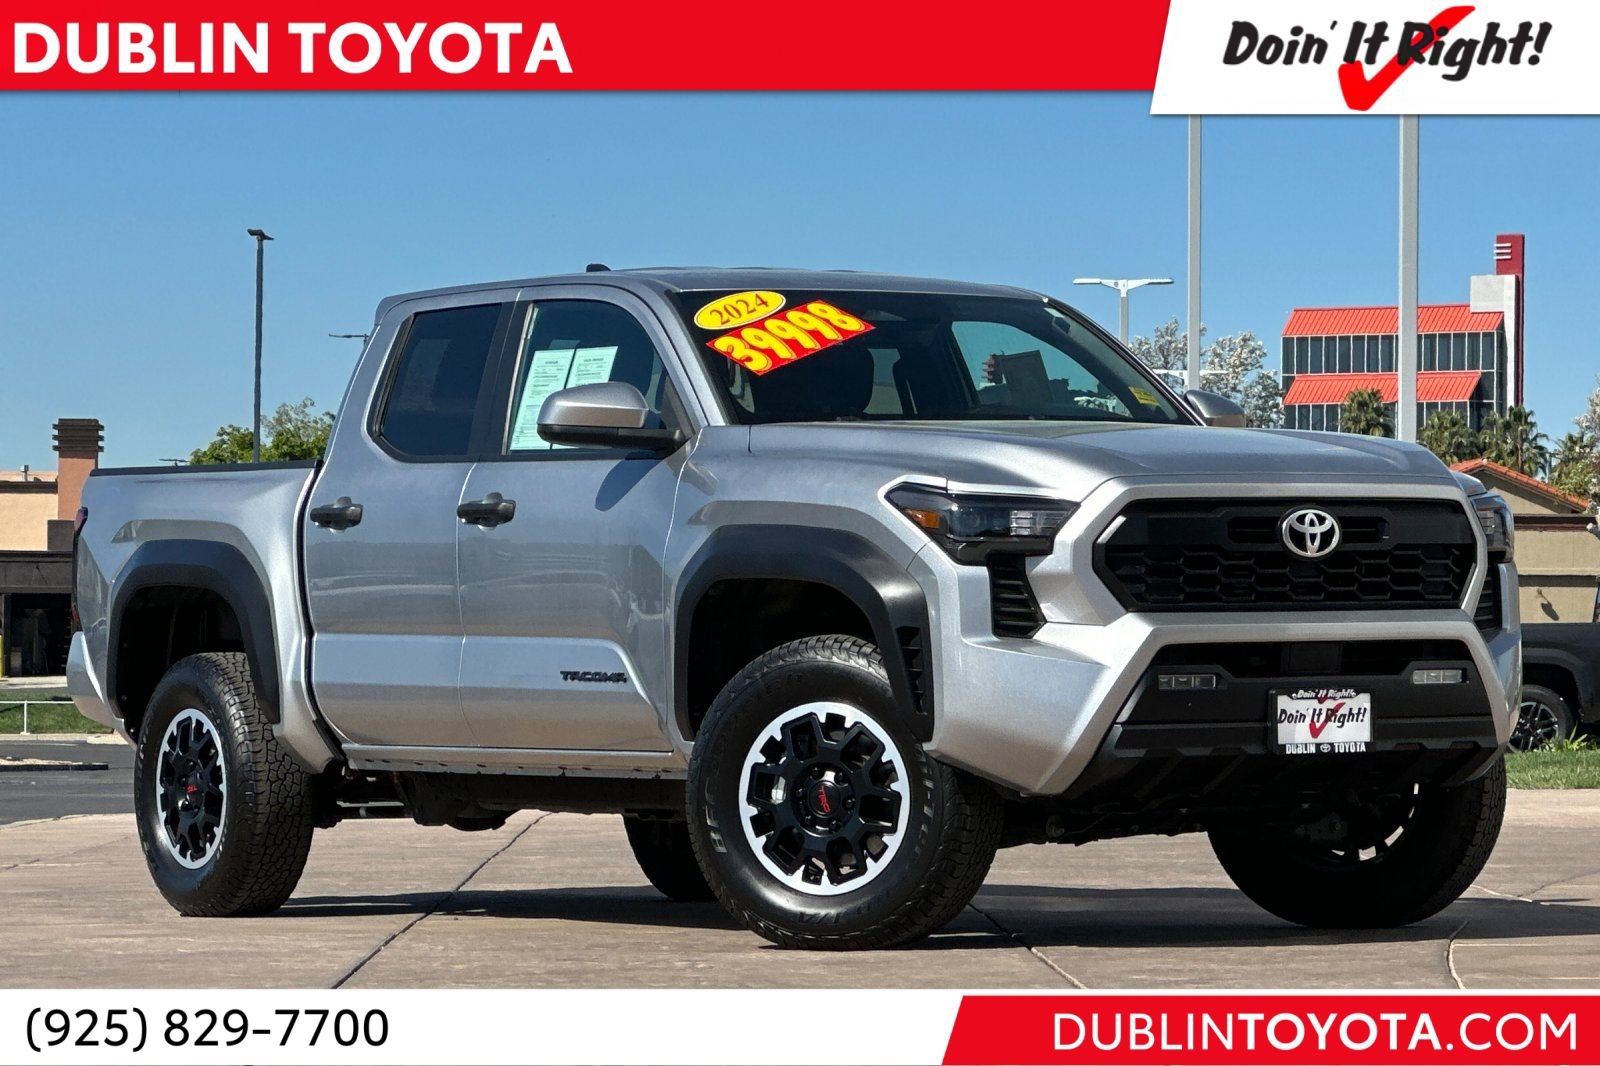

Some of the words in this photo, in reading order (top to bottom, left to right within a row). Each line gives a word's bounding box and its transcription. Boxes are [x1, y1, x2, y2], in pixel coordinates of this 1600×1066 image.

[709, 293, 768, 326] 2024
[713, 303, 865, 371] 39998
[559, 671, 627, 683] TACOMA
[1278, 707, 1309, 724] Doin'
[1310, 708, 1322, 723] It
[1325, 706, 1367, 728] Right!
[1285, 743, 1316, 755] DUBLIN
[1334, 741, 1366, 753] TOYOTA
